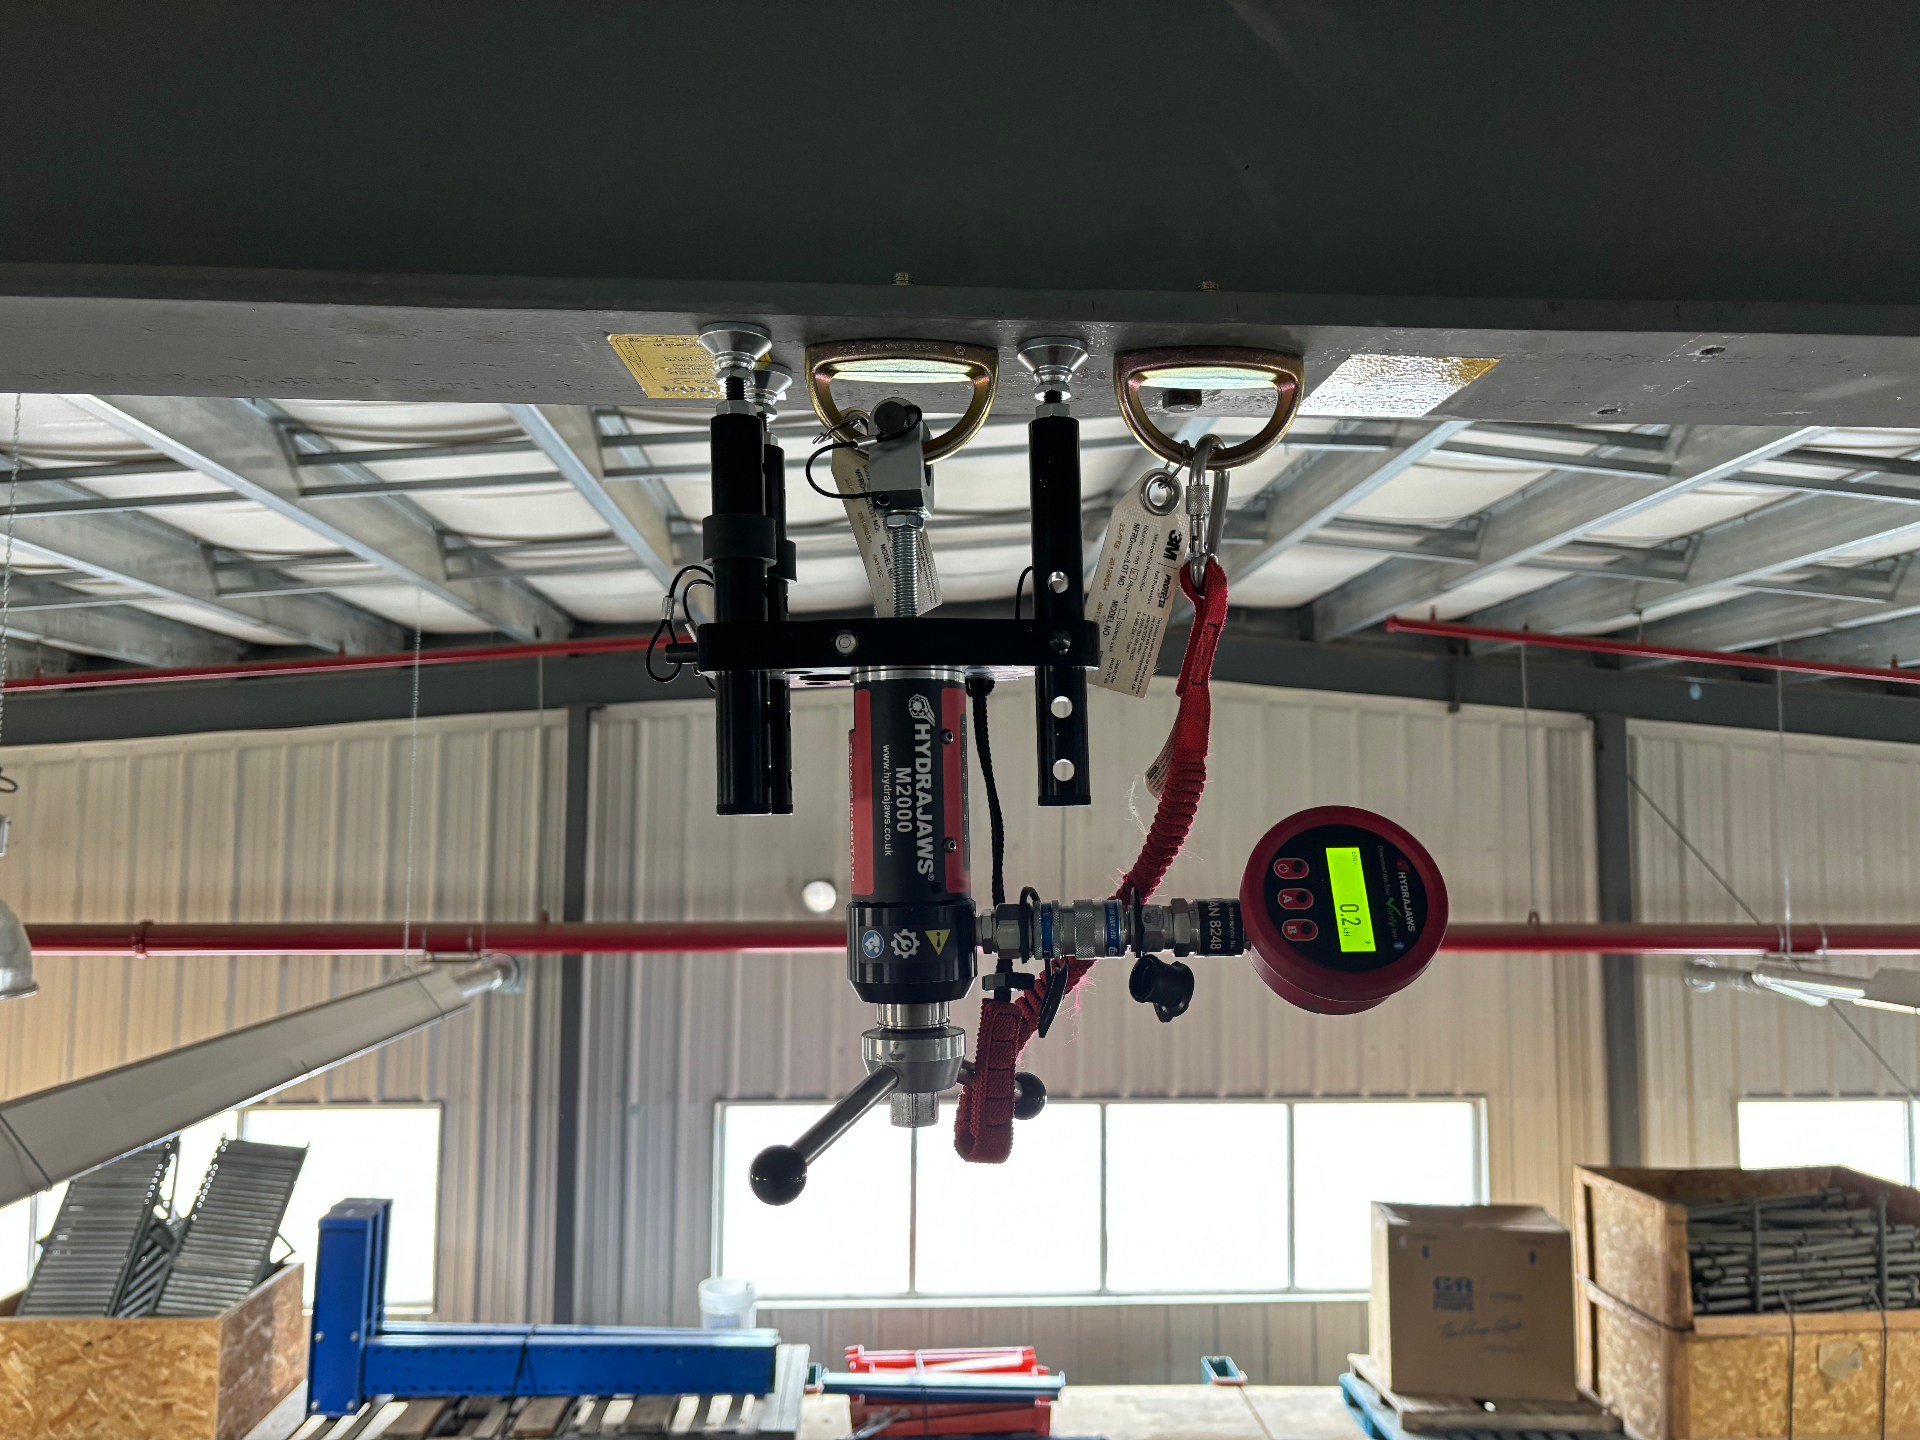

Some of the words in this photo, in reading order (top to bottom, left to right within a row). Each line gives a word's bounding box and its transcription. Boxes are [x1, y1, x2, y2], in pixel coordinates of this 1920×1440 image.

[880, 544, 891, 567] MODEL
[1163, 529, 1183, 561] 3M
[1117, 575, 1126, 588] NO:
[1157, 574, 1172, 608] PROTECTA
[1106, 600, 1119, 625] MODEL
[1102, 625, 1111, 638] NO:
[881, 744, 894, 856] www.hydrajaws.co.uk
[895, 767, 913, 833] M2000
[1282, 894, 1293, 903] A
[1397, 872, 1415, 932] HYDRAJAWS
[1339, 904, 1362, 926] 0.2
[1210, 920, 1222, 950] 8248
[1287, 926, 1298, 934] B
[1341, 927, 1351, 937] kN
